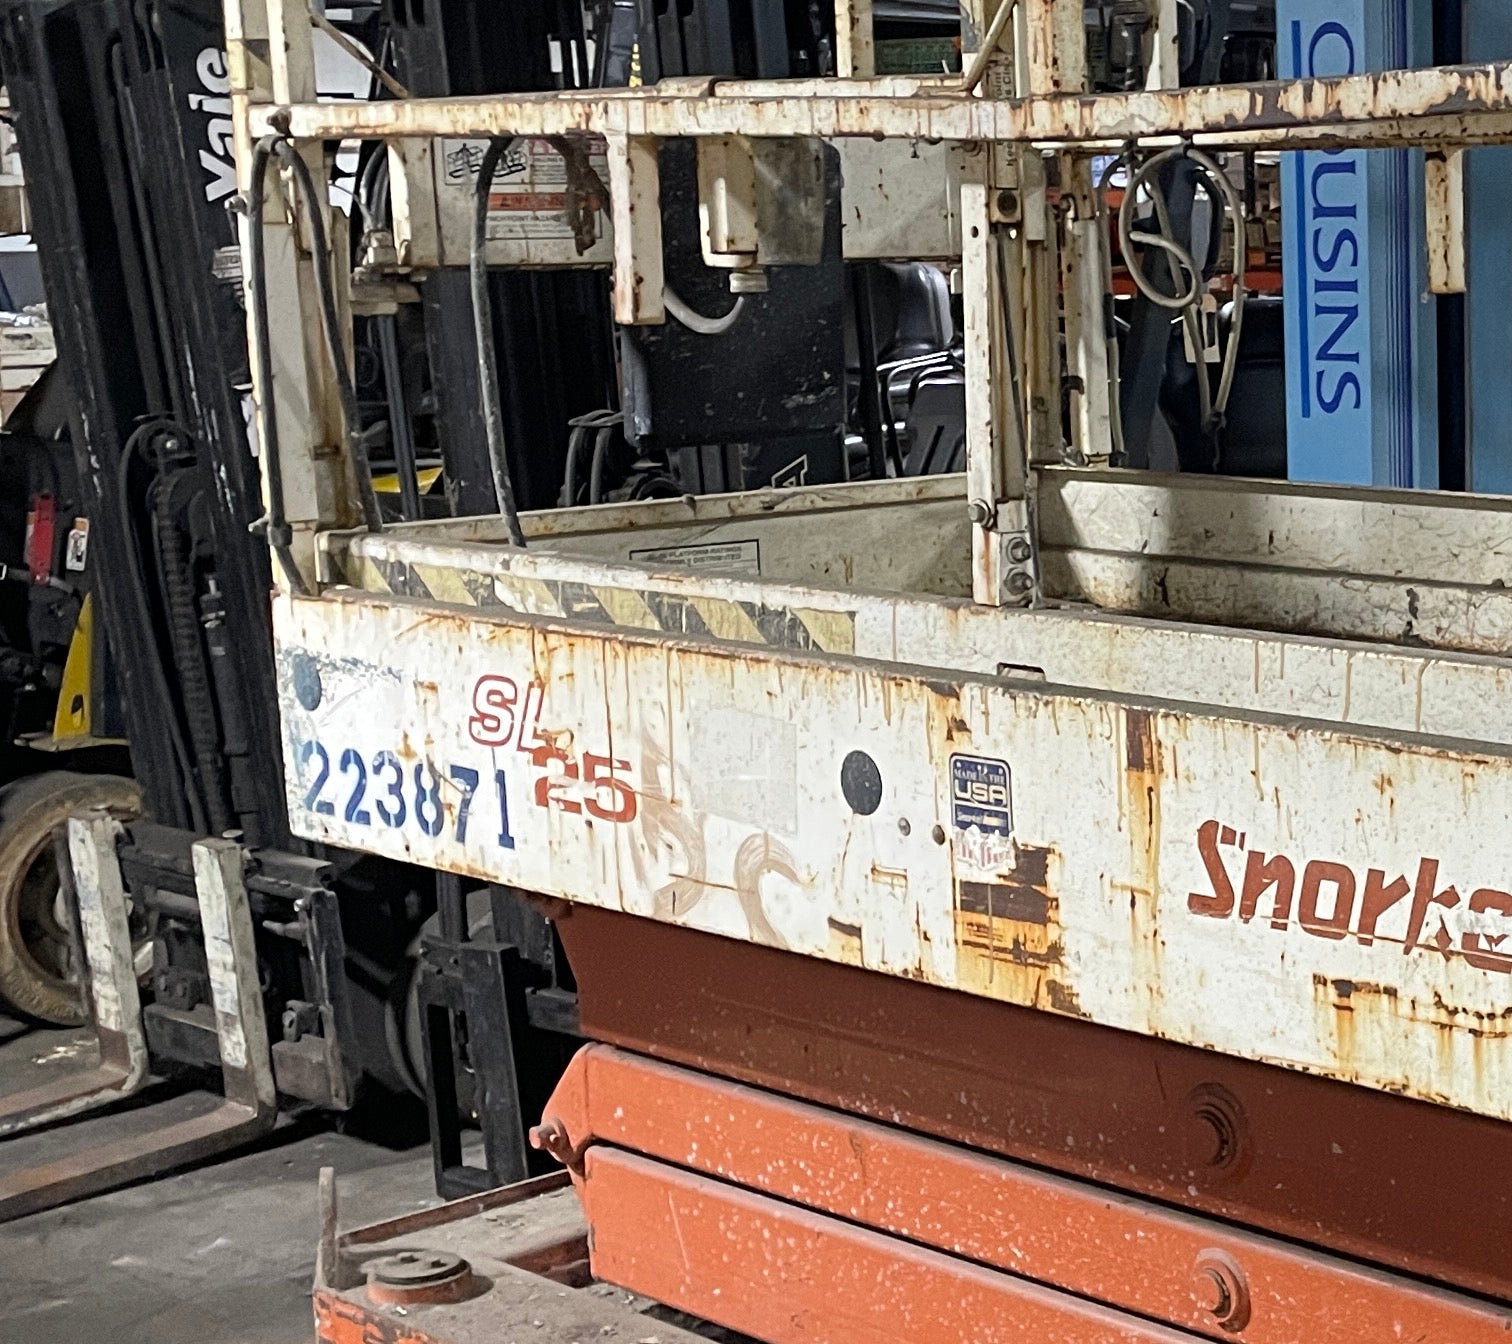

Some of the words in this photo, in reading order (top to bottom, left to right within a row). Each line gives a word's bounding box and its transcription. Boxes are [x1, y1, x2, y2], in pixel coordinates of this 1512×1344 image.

[188, 47, 238, 202] Yale
[1308, 21, 1362, 415] CUSINS
[300, 740, 515, 850] 223871
[954, 768, 977, 781] MADE
[989, 774, 1006, 785] THE
[954, 778, 1008, 808] USA
